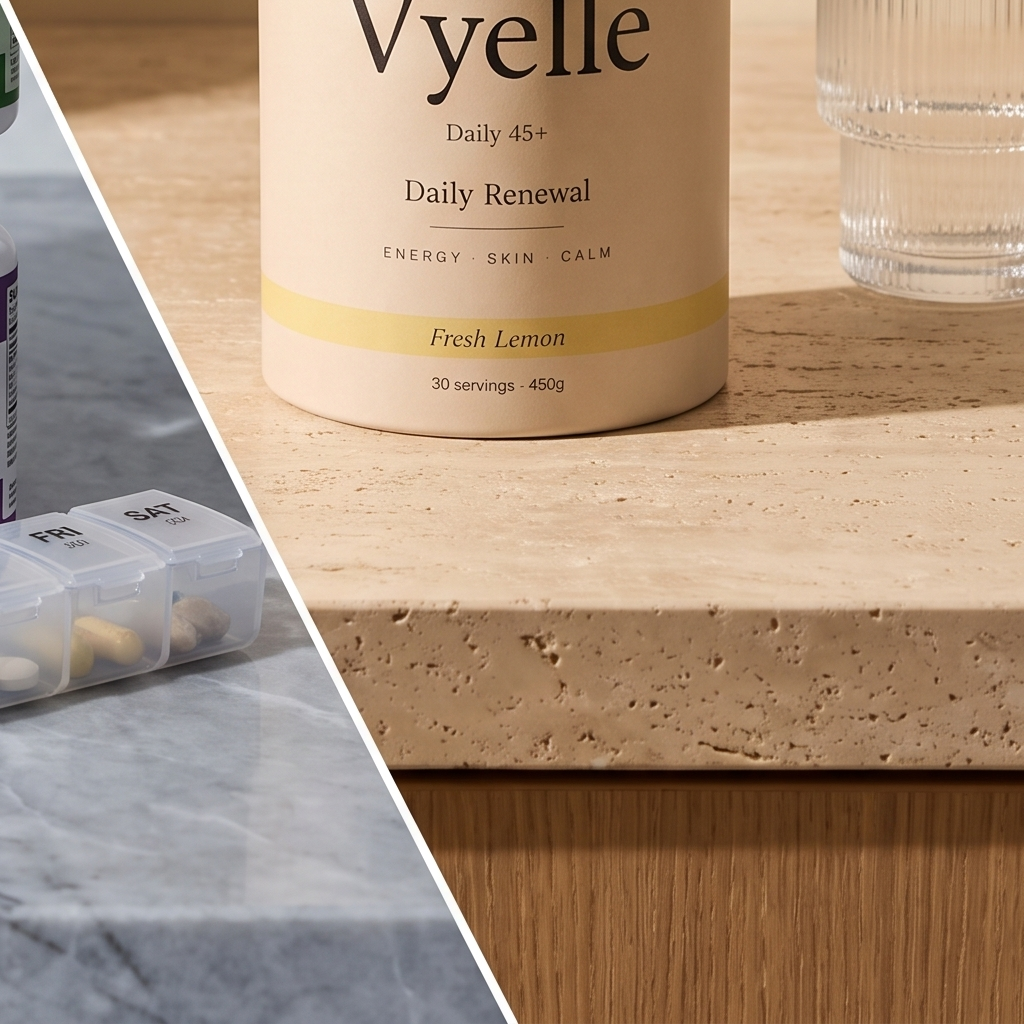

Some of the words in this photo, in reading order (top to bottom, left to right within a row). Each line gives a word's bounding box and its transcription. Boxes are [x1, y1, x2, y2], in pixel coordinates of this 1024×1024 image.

[447, 124, 501, 147] Daily
[509, 125, 547, 141] 45+
[405, 180, 474, 211] Daily
[485, 178, 590, 205] Renewal
[384, 247, 460, 263] ENERGY
[488, 253, 533, 264] SKIN
[561, 247, 610, 262] CALM
[431, 328, 485, 347] Fresh
[495, 330, 564, 347] Lemon
[432, 377, 449, 390] 30
[454, 381, 515, 395] servings
[529, 378, 564, 393] 450g
[124, 502, 181, 522] SAT
[29, 526, 83, 544] FRI
